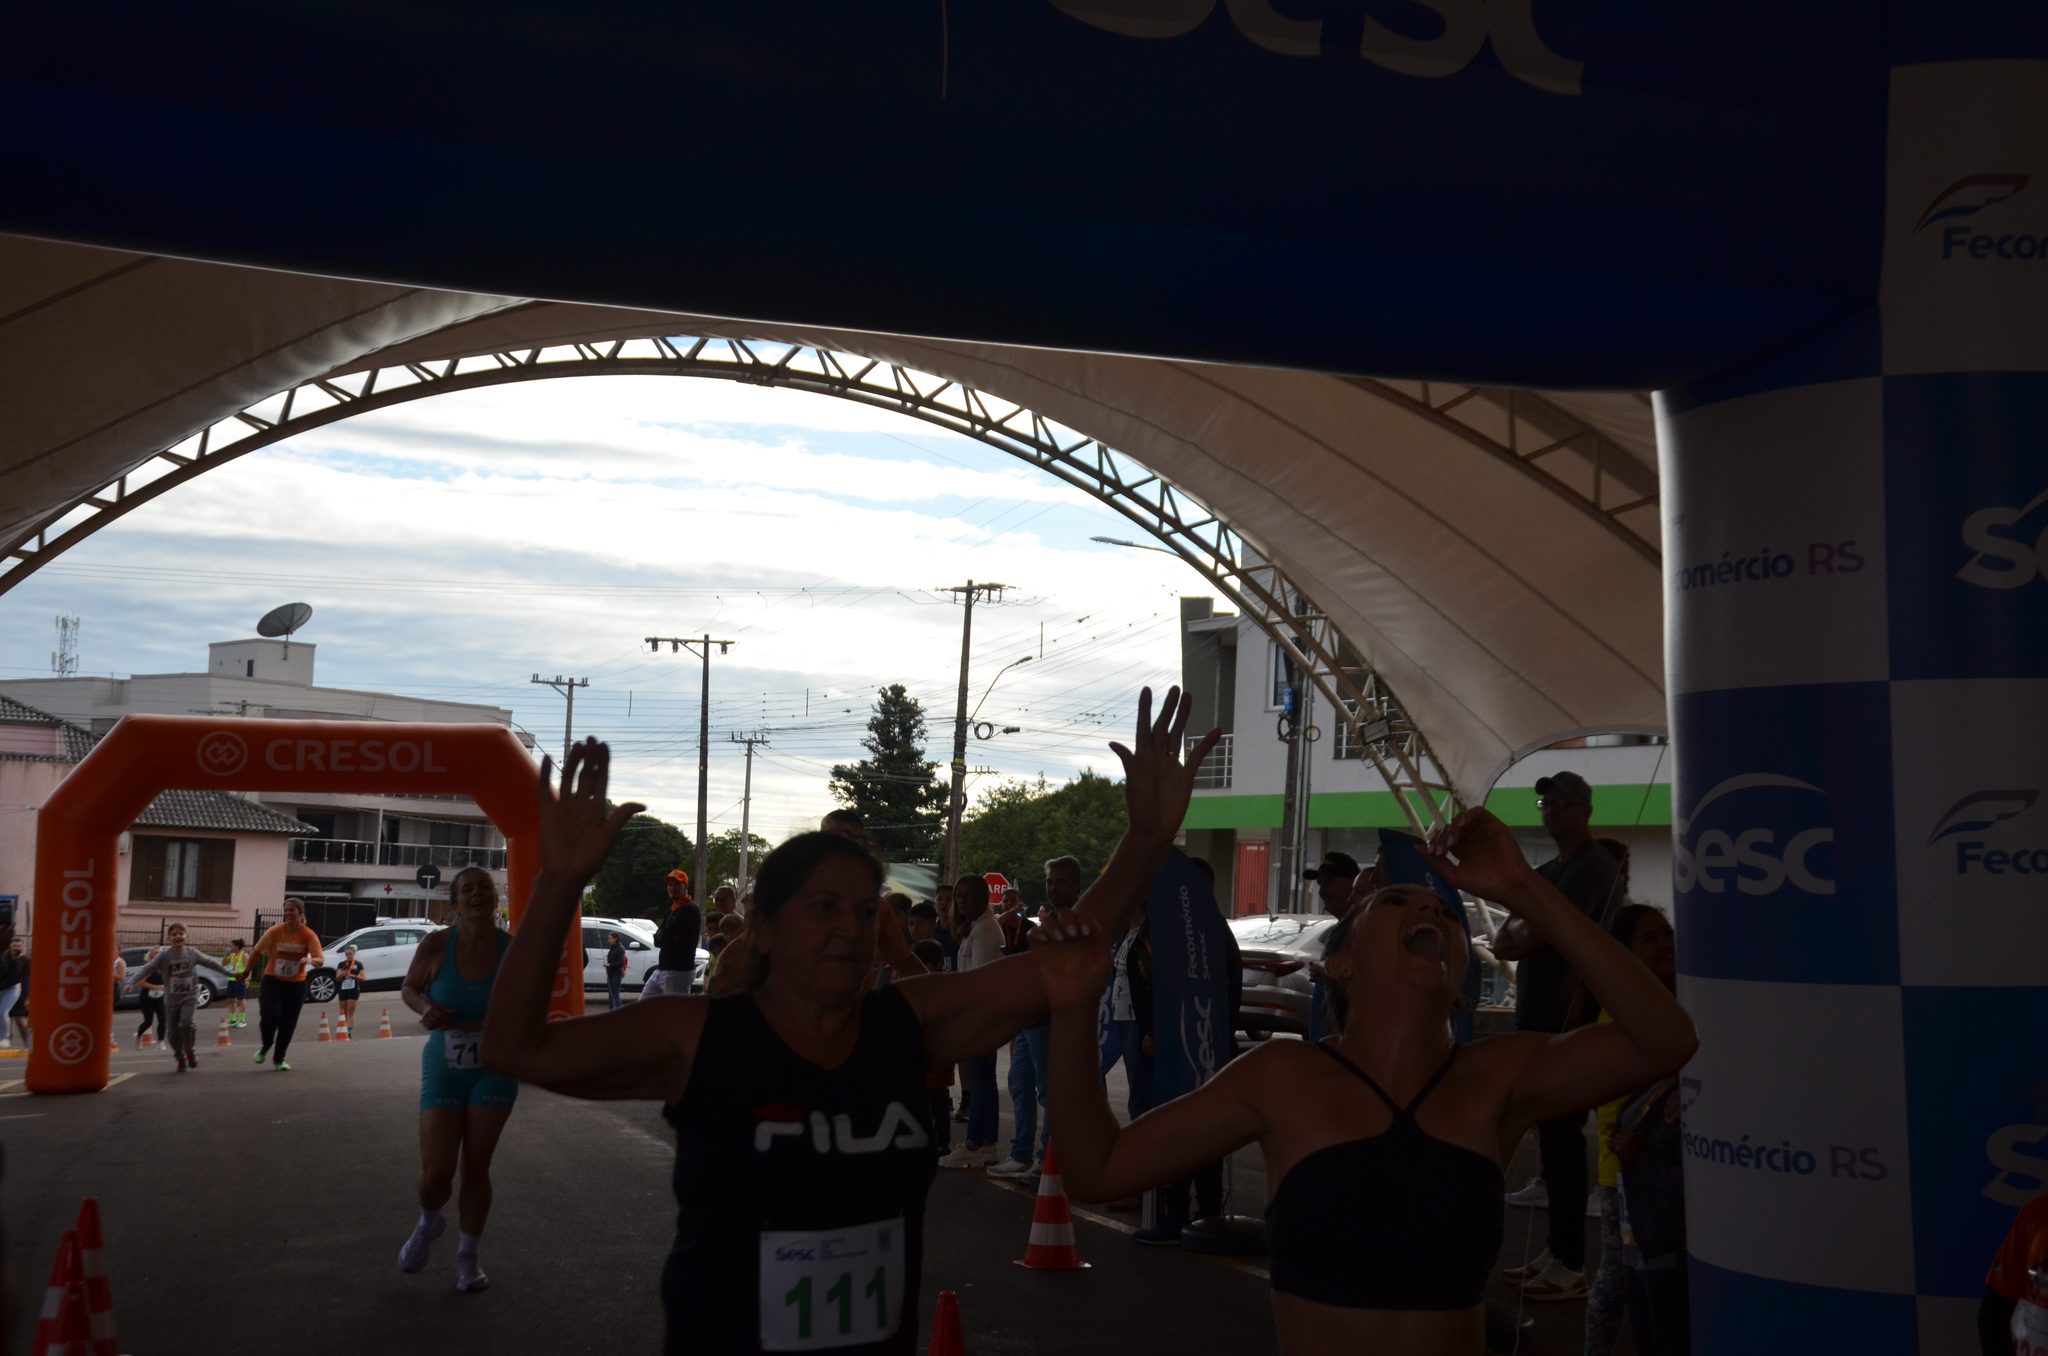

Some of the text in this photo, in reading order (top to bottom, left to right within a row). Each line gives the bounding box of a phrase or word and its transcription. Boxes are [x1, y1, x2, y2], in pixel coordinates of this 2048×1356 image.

[1942, 226, 2048, 260] Feco
[1676, 540, 1865, 592] omércio RS
[264, 738, 448, 773] CRESOL
[987, 884, 1008, 894] ARE
[57, 857, 96, 1010] CRESOL
[1179, 884, 1200, 980] Fecomércio
[453, 1042, 478, 1065] 71
[752, 1100, 930, 1155] FILA
[1829, 1145, 1889, 1181] RS
[785, 1265, 887, 1338] 111
